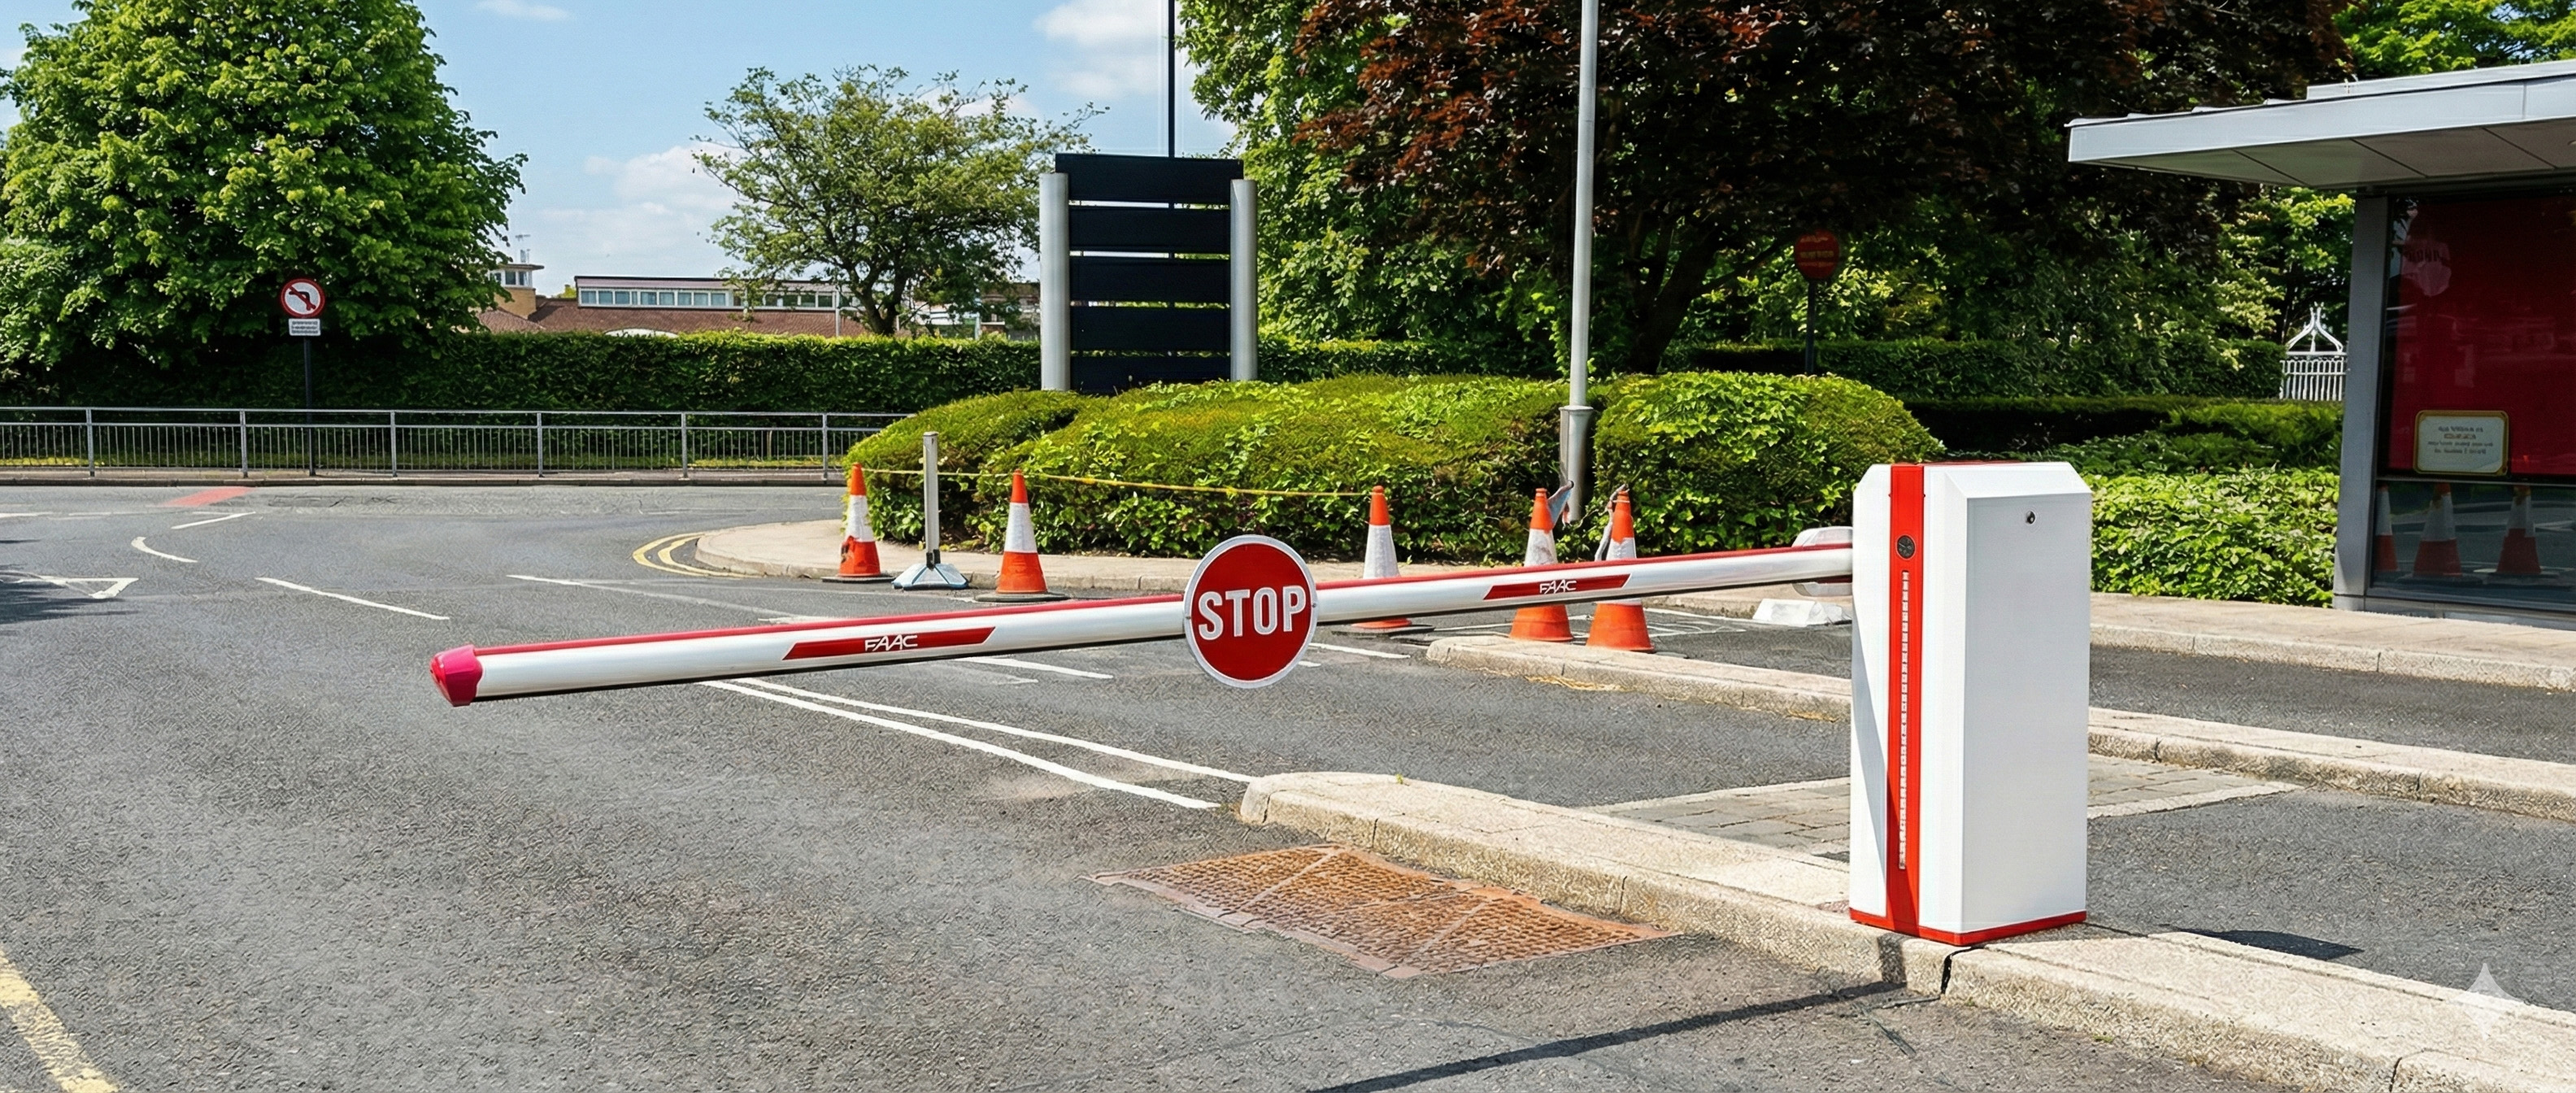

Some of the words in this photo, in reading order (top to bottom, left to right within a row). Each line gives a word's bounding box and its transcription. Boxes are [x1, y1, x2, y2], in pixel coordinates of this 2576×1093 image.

[1539, 579, 1577, 594] FAAC
[1199, 586, 1307, 641] STOP
[864, 634, 918, 651] FAAC
